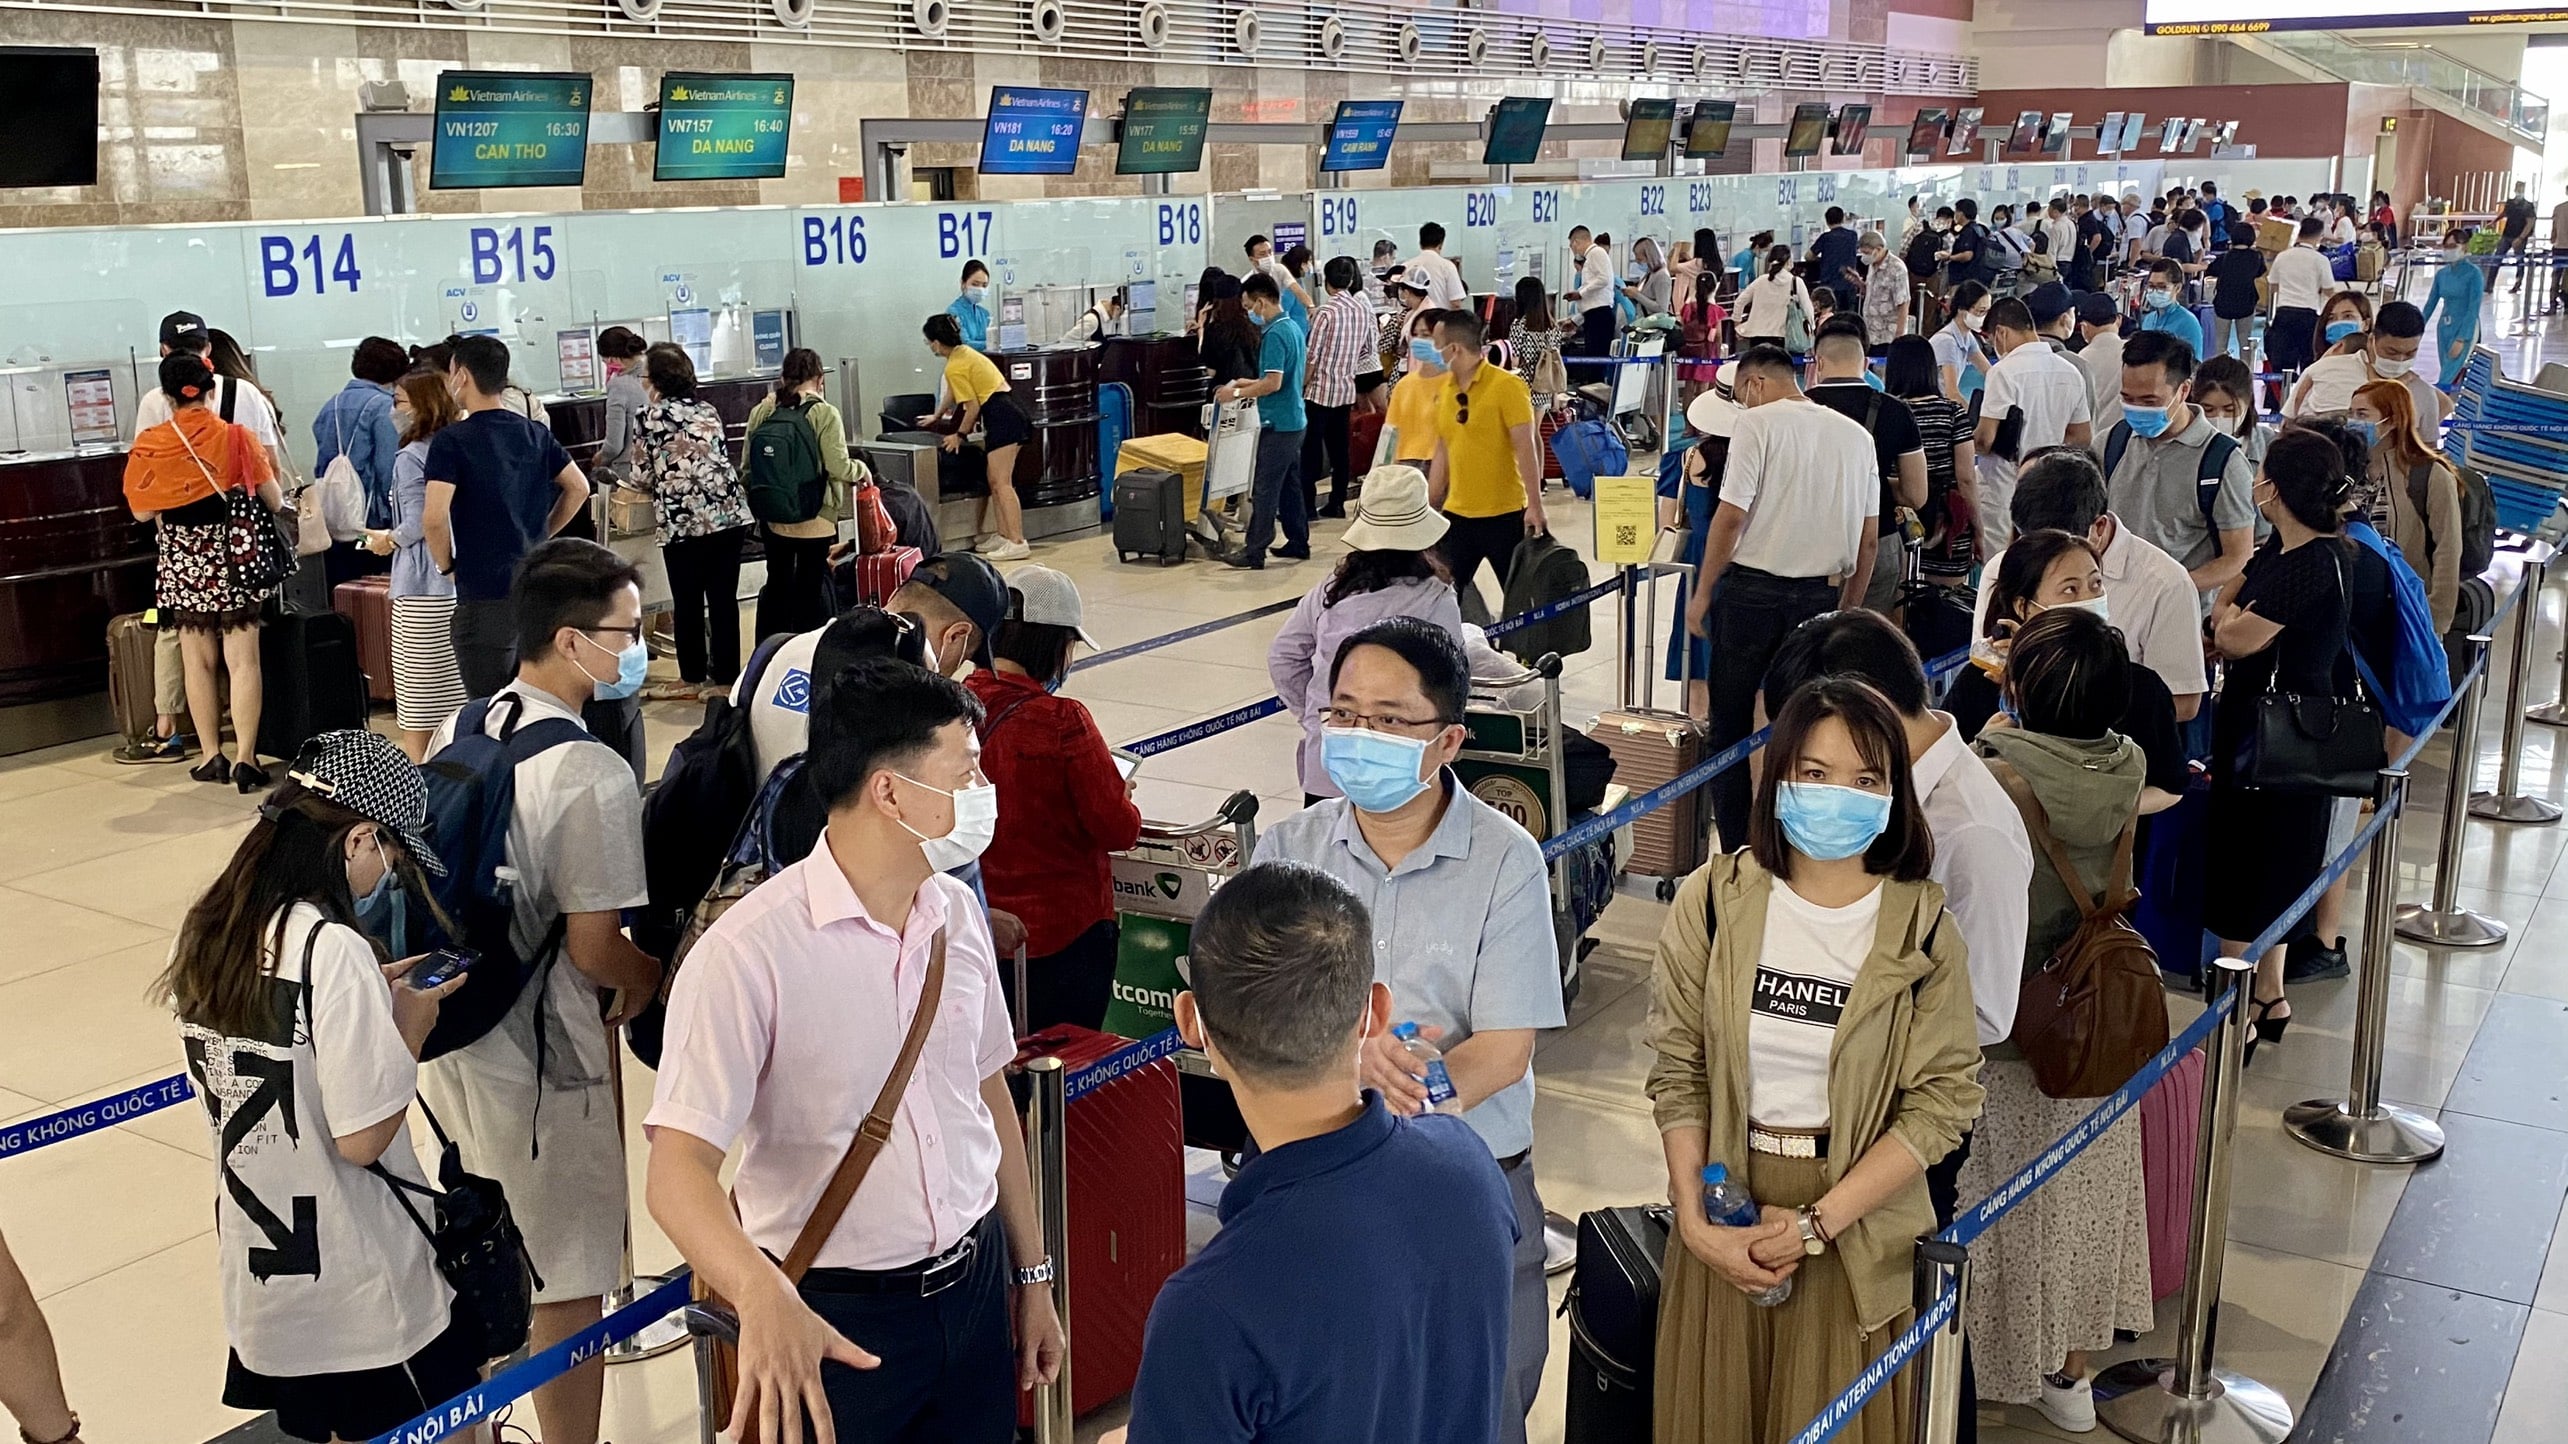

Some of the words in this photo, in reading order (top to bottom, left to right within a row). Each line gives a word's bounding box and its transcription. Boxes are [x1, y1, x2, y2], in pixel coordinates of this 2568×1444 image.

[2156, 25, 2200, 35] GOLDSUN
[2211, 24, 2228, 33] 090
[2229, 24, 2246, 32] 464
[2247, 22, 2271, 32] 6699
[446, 122, 499, 137] VN1207
[545, 122, 580, 137] 16:30
[668, 119, 713, 133] VN7157
[754, 119, 783, 133] 16:40
[994, 122, 1022, 134] VN181
[1051, 124, 1074, 136] 16:20
[1128, 125, 1154, 136] VN177
[475, 144, 509, 160] CAN
[514, 143, 546, 159] THO
[692, 140, 711, 154] DA
[715, 139, 754, 153] NANG
[1009, 139, 1024, 152] DA
[1026, 140, 1055, 153] NANG
[1142, 141, 1155, 153] DA
[1157, 141, 1182, 152] NANG
[1640, 185, 1664, 215] B22
[1689, 183, 1711, 212] B23
[1777, 179, 1797, 205] B24
[1817, 176, 1835, 202] B25
[1322, 198, 1357, 235] B19
[1467, 193, 1496, 227] B20
[1533, 190, 1558, 222] B21
[939, 211, 993, 258] B17
[1158, 204, 1201, 245] B18
[803, 215, 867, 266] B16
[261, 232, 361, 297] B14
[471, 226, 556, 285] B15
[663, 274, 681, 282] ACV
[446, 288, 466, 297] ACV
[1178, 725, 1203, 743] KHÔNG
[1205, 717, 1225, 734] QUỐC
[1226, 712, 1235, 726] TẾ
[1495, 789, 1512, 797] TOP
[1485, 800, 1527, 827] 00
[1113, 876, 1157, 898] bank
[1113, 979, 1176, 1010] tcom
[1757, 974, 1846, 1007] HANEL
[1769, 1000, 1808, 1016] PARIS
[1078, 1061, 1120, 1092] KHÔNG
[1123, 1041, 1156, 1070] QUỐC
[1160, 1031, 1173, 1053] TẾ
[28, 1111, 96, 1144] KHÔNG
[102, 1090, 154, 1120] QUỐC
[159, 1077, 181, 1101] TẾ
[257, 1134, 278, 1144] FIT
[1836, 1334, 1921, 1420] INTERNATIONAL
